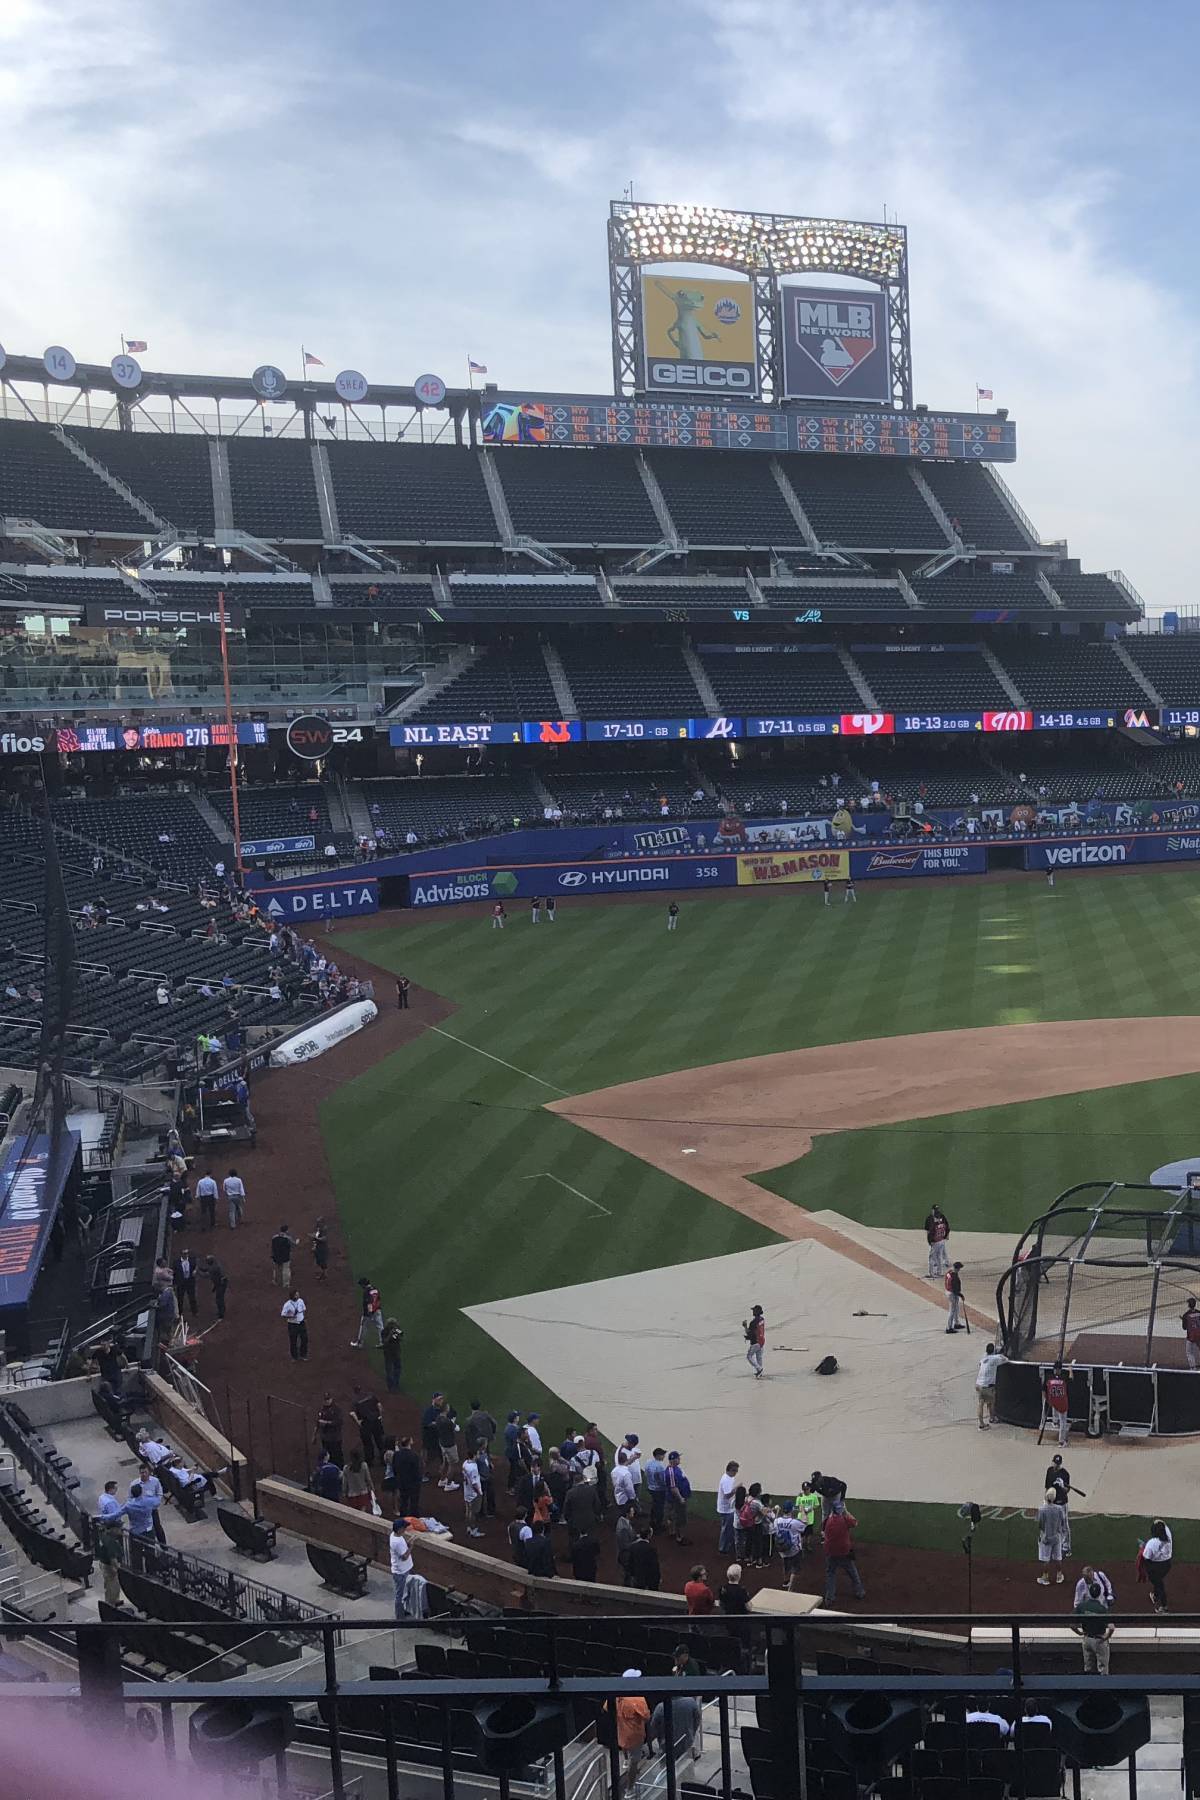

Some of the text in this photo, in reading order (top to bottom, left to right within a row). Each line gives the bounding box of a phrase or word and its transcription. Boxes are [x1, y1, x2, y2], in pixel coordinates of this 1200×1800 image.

[800, 303, 871, 330] MLB
[800, 326, 872, 338] NETWORK
[52, 355, 66, 370] 14
[117, 364, 134, 379] 37
[653, 363, 750, 387] GEICO
[421, 383, 440, 397] 42
[611, 402, 729, 413] AMERICAN LEAGUE
[855, 413, 958, 424] NATIONAL LEAGUE
[104, 609, 231, 623] PORSCHE
[733, 611, 750, 621] VS
[904, 717, 970, 730] 16-13 2.0 GB
[1039, 715, 1101, 727] 14-16 4.5 GB
[1107, 718, 1114, 728] 5
[1169, 712, 1199, 724] 11-18
[603, 724, 669, 738] 17-10 GB
[758, 720, 826, 734] 17-11 0.5 GB
[832, 724, 840, 734] 3
[975, 721, 982, 731] 4
[87, 734, 107, 742] SAVES
[144, 733, 184, 749] FRANCO
[186, 728, 209, 746] 276
[290, 729, 363, 744] SW 24
[403, 725, 492, 743] NL EAST
[513, 732, 521, 743] 1
[679, 728, 687, 738] 2
[0, 732, 45, 753] fios
[80, 742, 100, 751] SINCE
[923, 847, 969, 858] THIS BUD'S
[1045, 841, 1126, 865] verizon
[872, 854, 918, 867] Budweiser
[923, 858, 961, 868] FOR YOU.
[456, 872, 488, 883] BLOCK
[591, 867, 669, 884] HYUNDAI
[695, 867, 719, 878] 358
[293, 888, 373, 912] DELTA
[413, 882, 490, 905] Advisors
